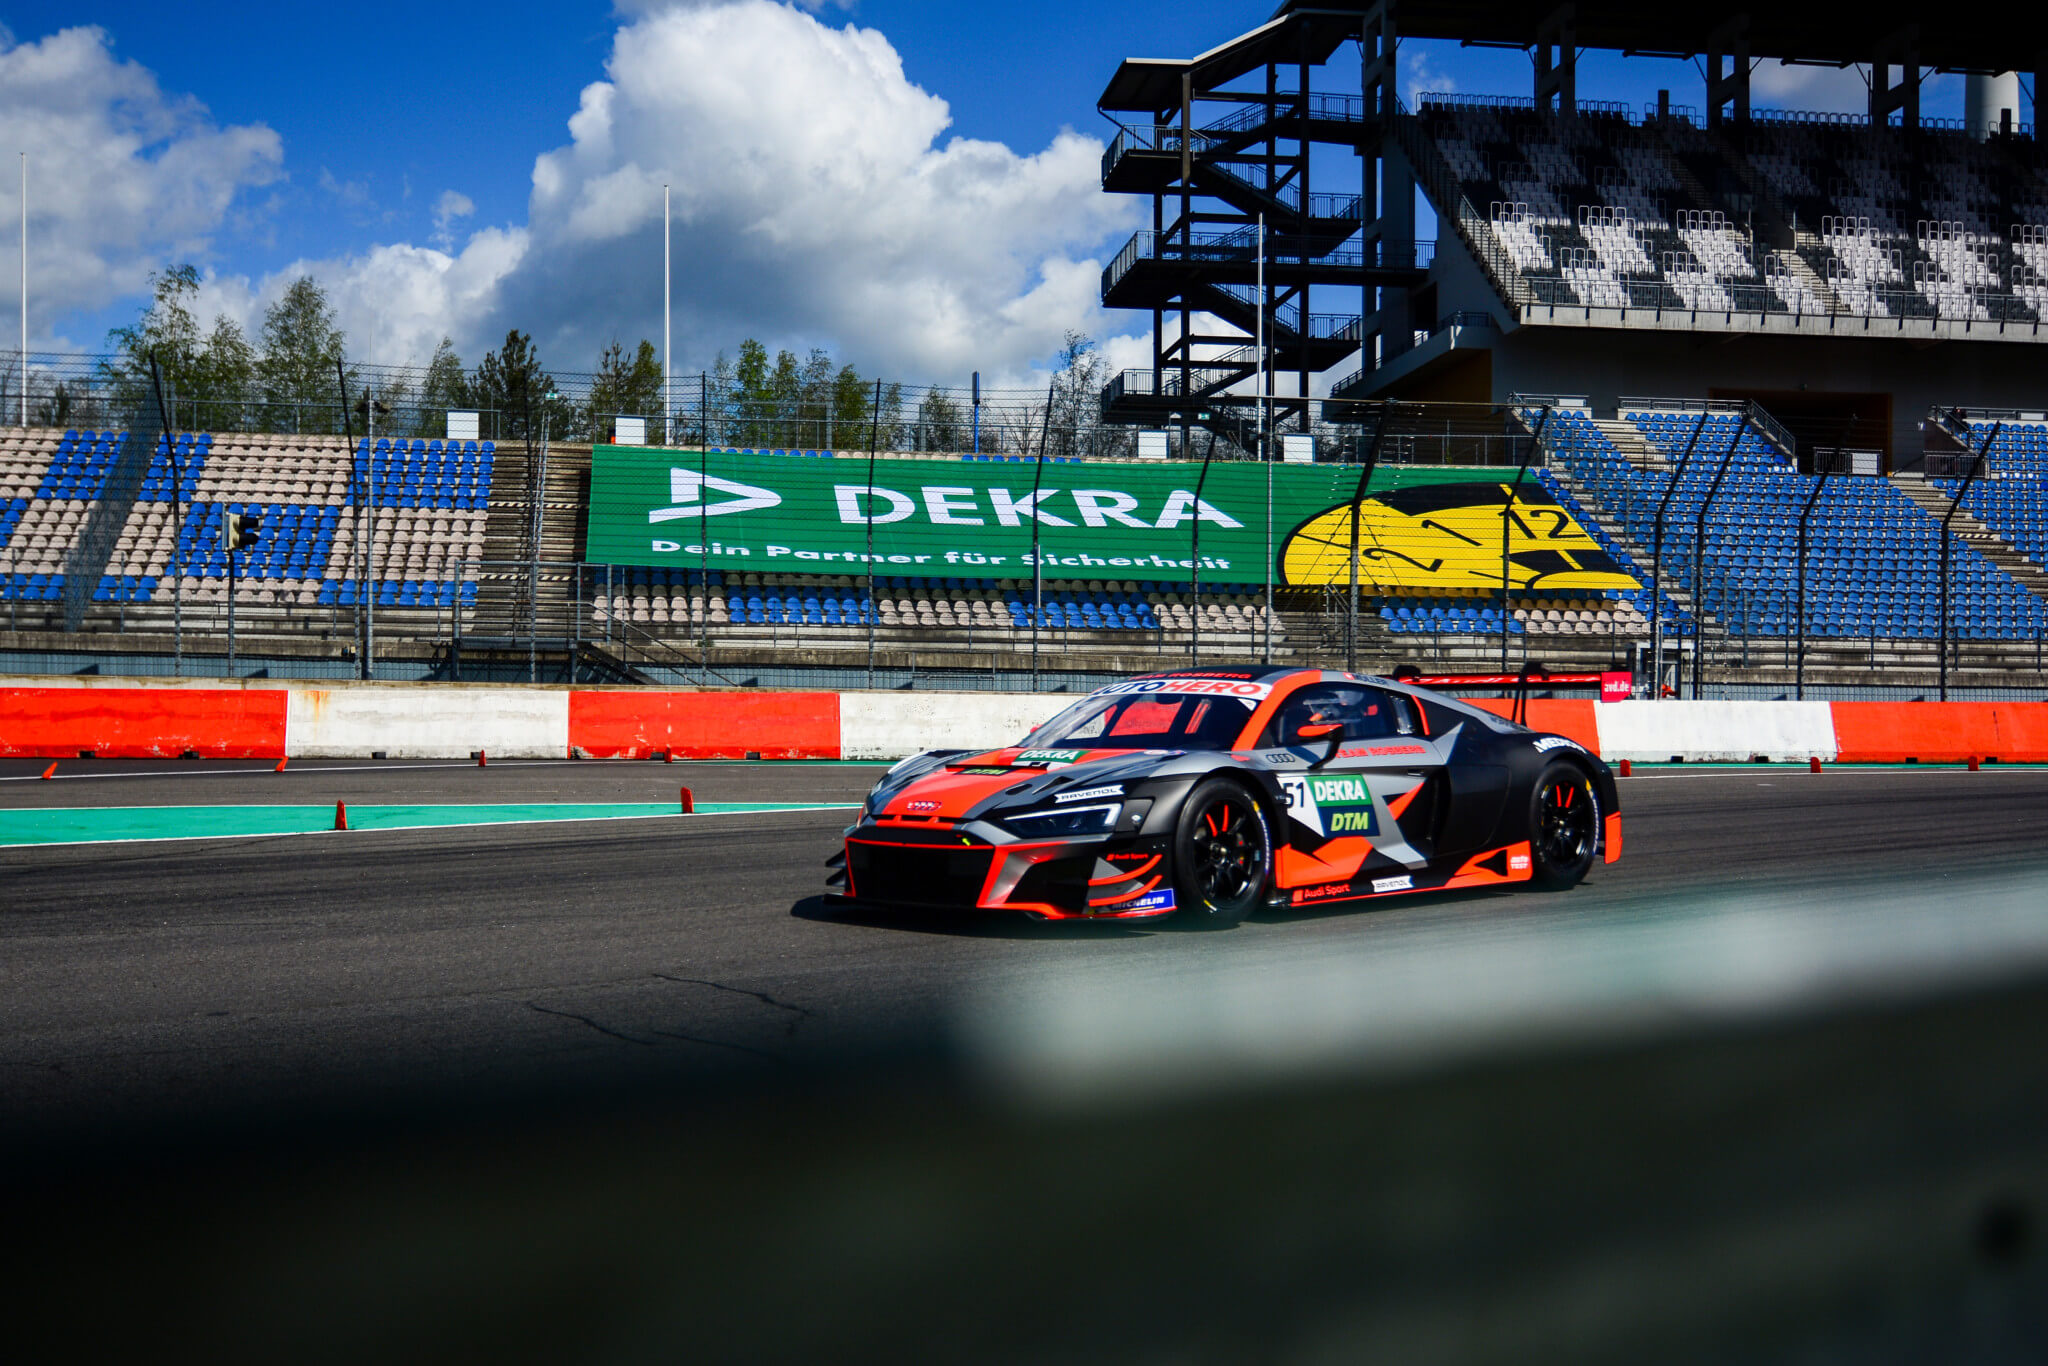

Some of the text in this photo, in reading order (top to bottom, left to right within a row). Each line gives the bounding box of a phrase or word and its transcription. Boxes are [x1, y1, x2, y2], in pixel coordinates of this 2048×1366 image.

[834, 485, 1245, 528] DEKRA
[1497, 509, 1588, 540] 12
[652, 540, 1231, 569] Dein Partner für Sicherheit
[1604, 681, 1629, 692] avd.de
[1018, 750, 1078, 761] DEKRA
[1061, 788, 1118, 800] RAVENOL
[1313, 780, 1366, 802] DEKRA
[1330, 811, 1369, 832] DTM
[1304, 883, 1351, 898] Audi Sport
